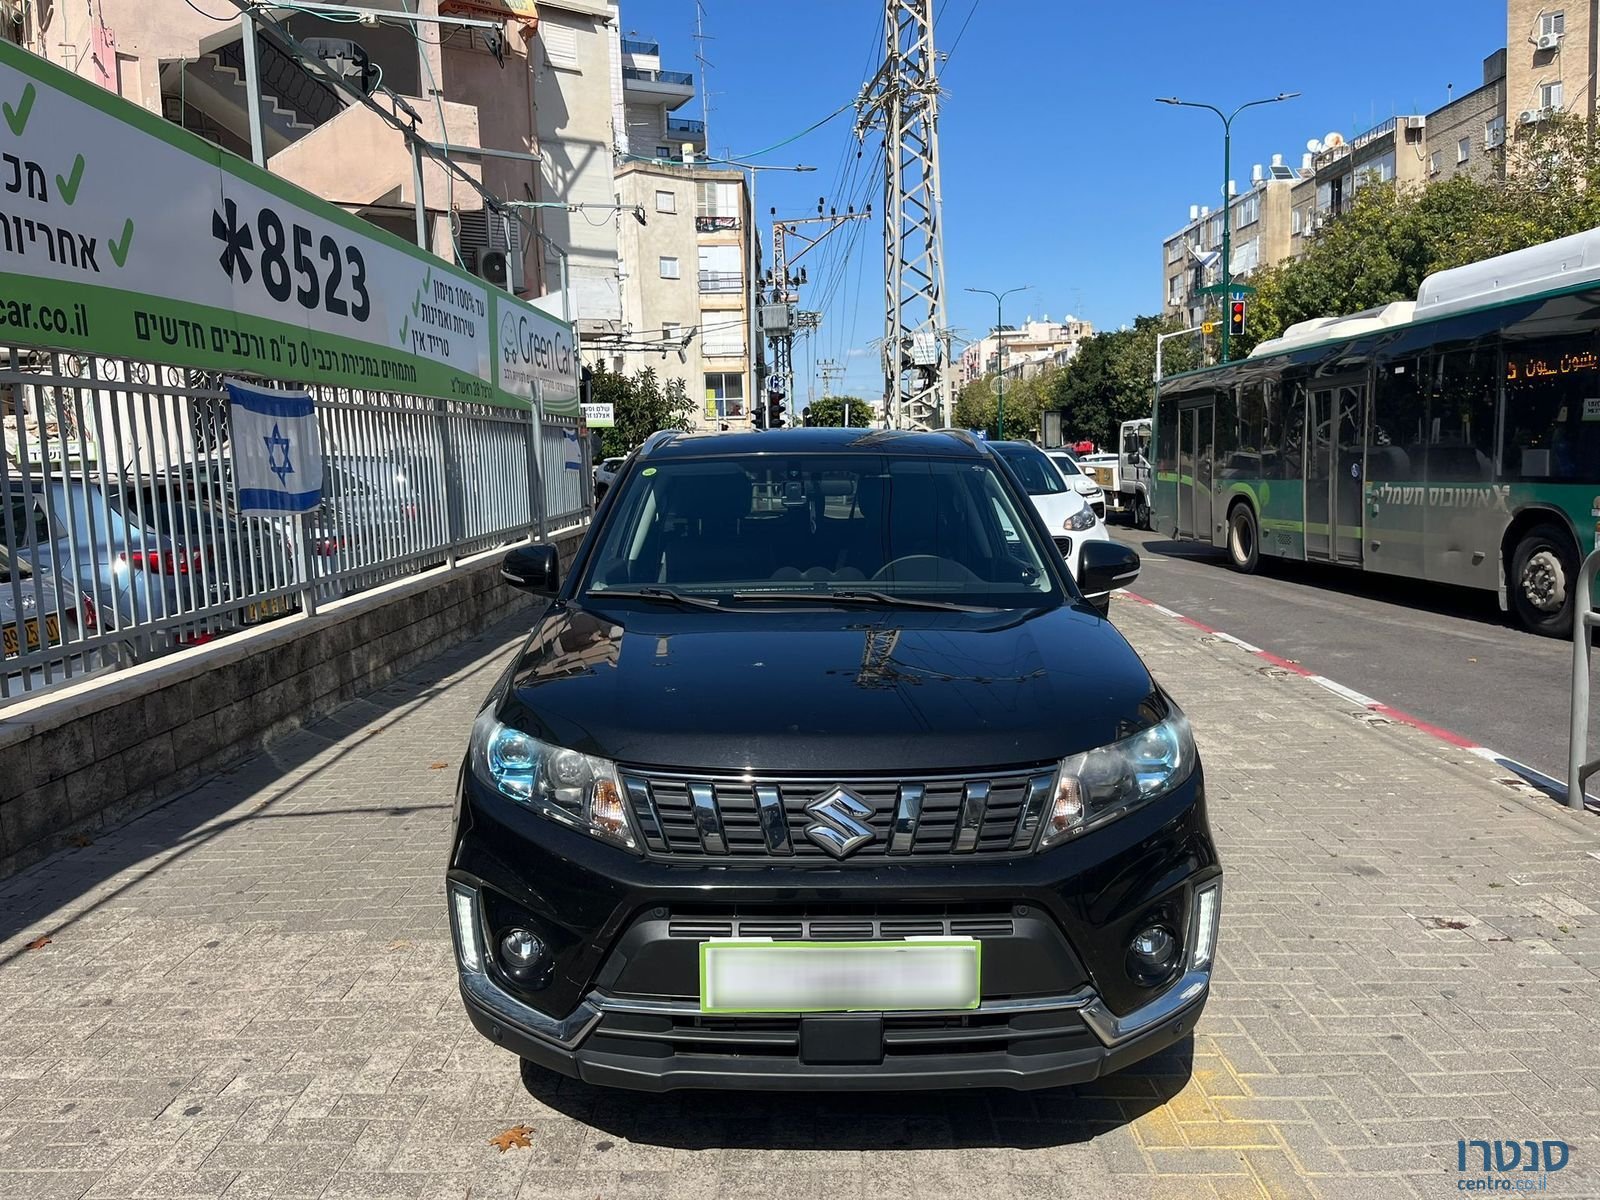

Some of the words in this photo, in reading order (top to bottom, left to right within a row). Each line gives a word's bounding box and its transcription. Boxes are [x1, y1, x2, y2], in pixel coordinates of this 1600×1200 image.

[433, 279, 454, 304] מימון
[455, 287, 475, 313] 100%
[421, 303, 452, 331] ואמינות
[476, 299, 485, 318] עד
[134, 310, 206, 350] חדשים
[453, 315, 475, 338] שירות
[210, 326, 266, 360] ורכבים
[269, 335, 297, 367] ק"מ
[412, 329, 426, 355] אין
[427, 334, 450, 357] טרייד
[519, 316, 554, 370] Green
[555, 332, 571, 375] Car
[312, 348, 340, 372] רכבי
[341, 352, 379, 378] במכירת
[381, 360, 417, 383] מתמחים
[1380, 482, 1424, 505] חשמלי
[1429, 487, 1490, 507] אוטובוס
